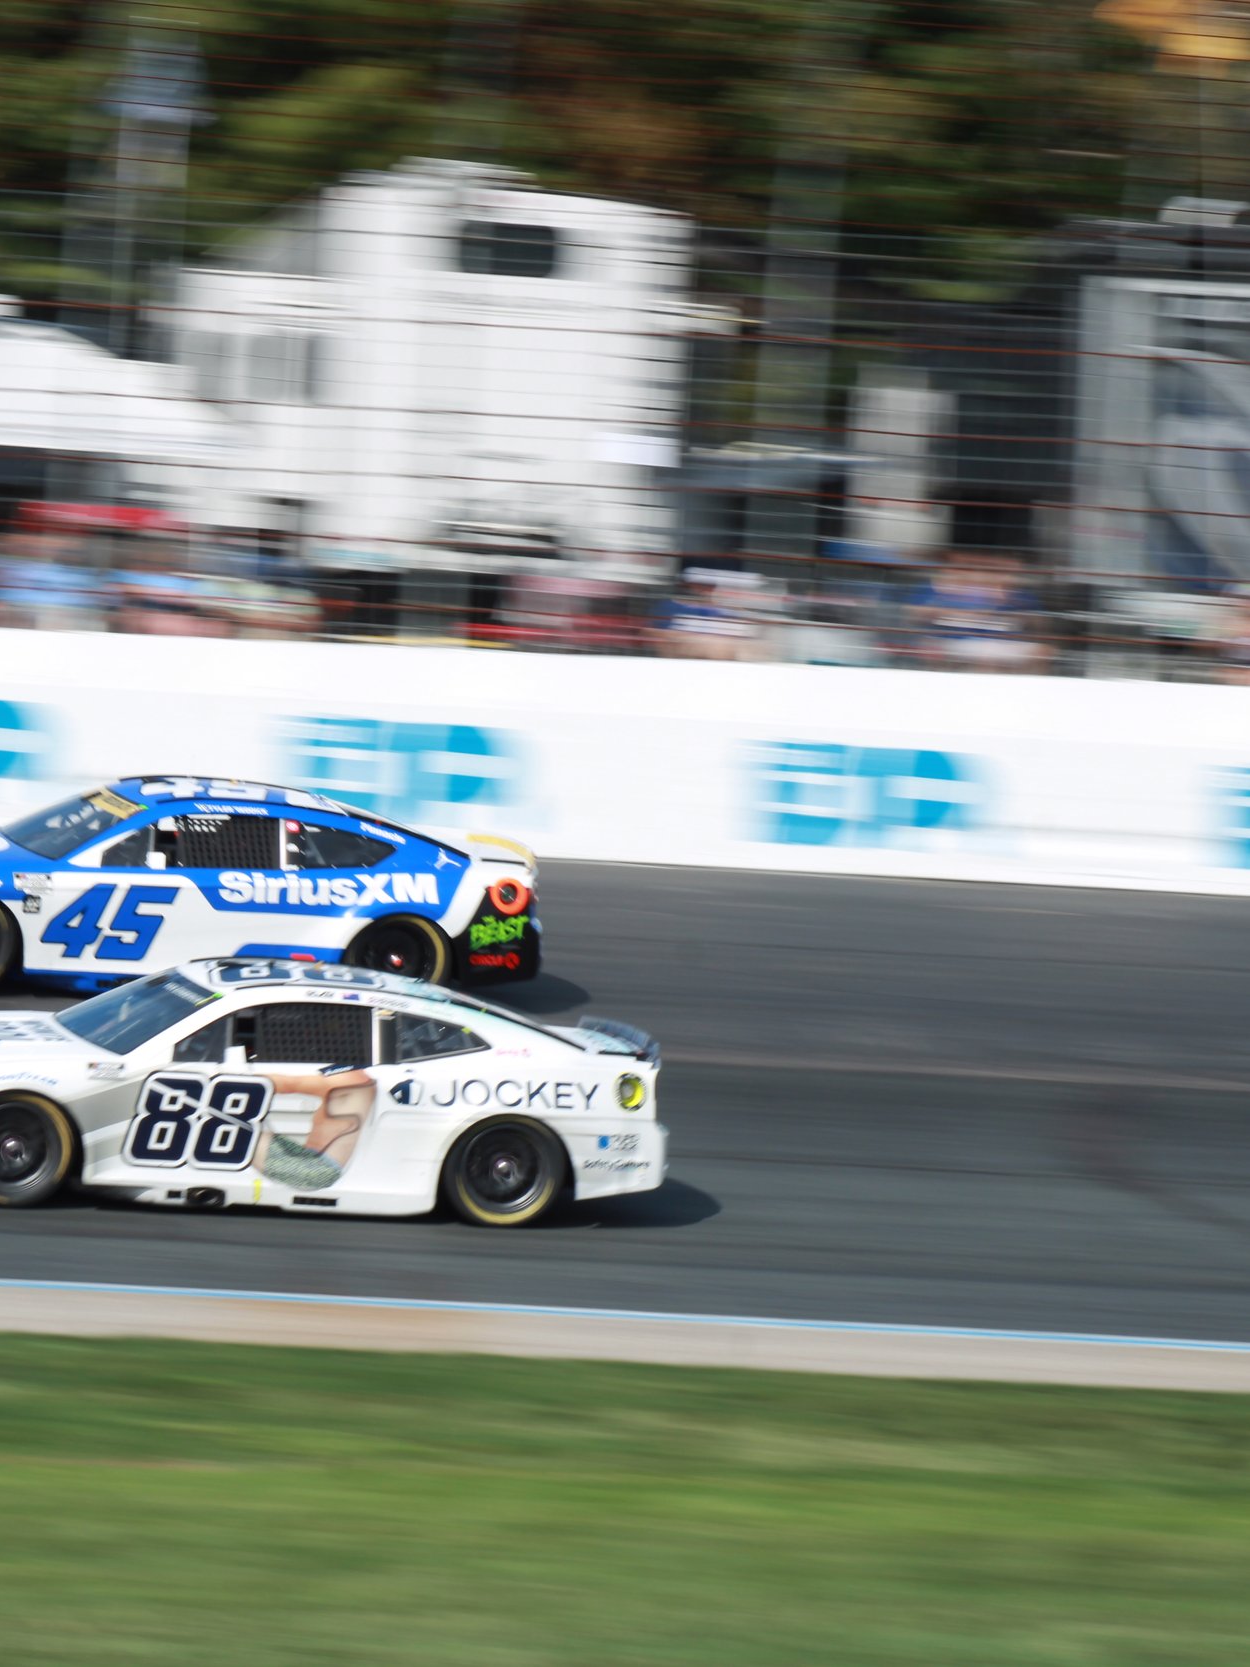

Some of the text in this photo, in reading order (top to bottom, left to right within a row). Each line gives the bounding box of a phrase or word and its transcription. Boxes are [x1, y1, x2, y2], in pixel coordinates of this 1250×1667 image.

[218, 871, 440, 906] SiriusXM
[40, 883, 181, 961] 45
[122, 1070, 275, 1171] 88
[431, 1078, 599, 1110] JOCKEY
